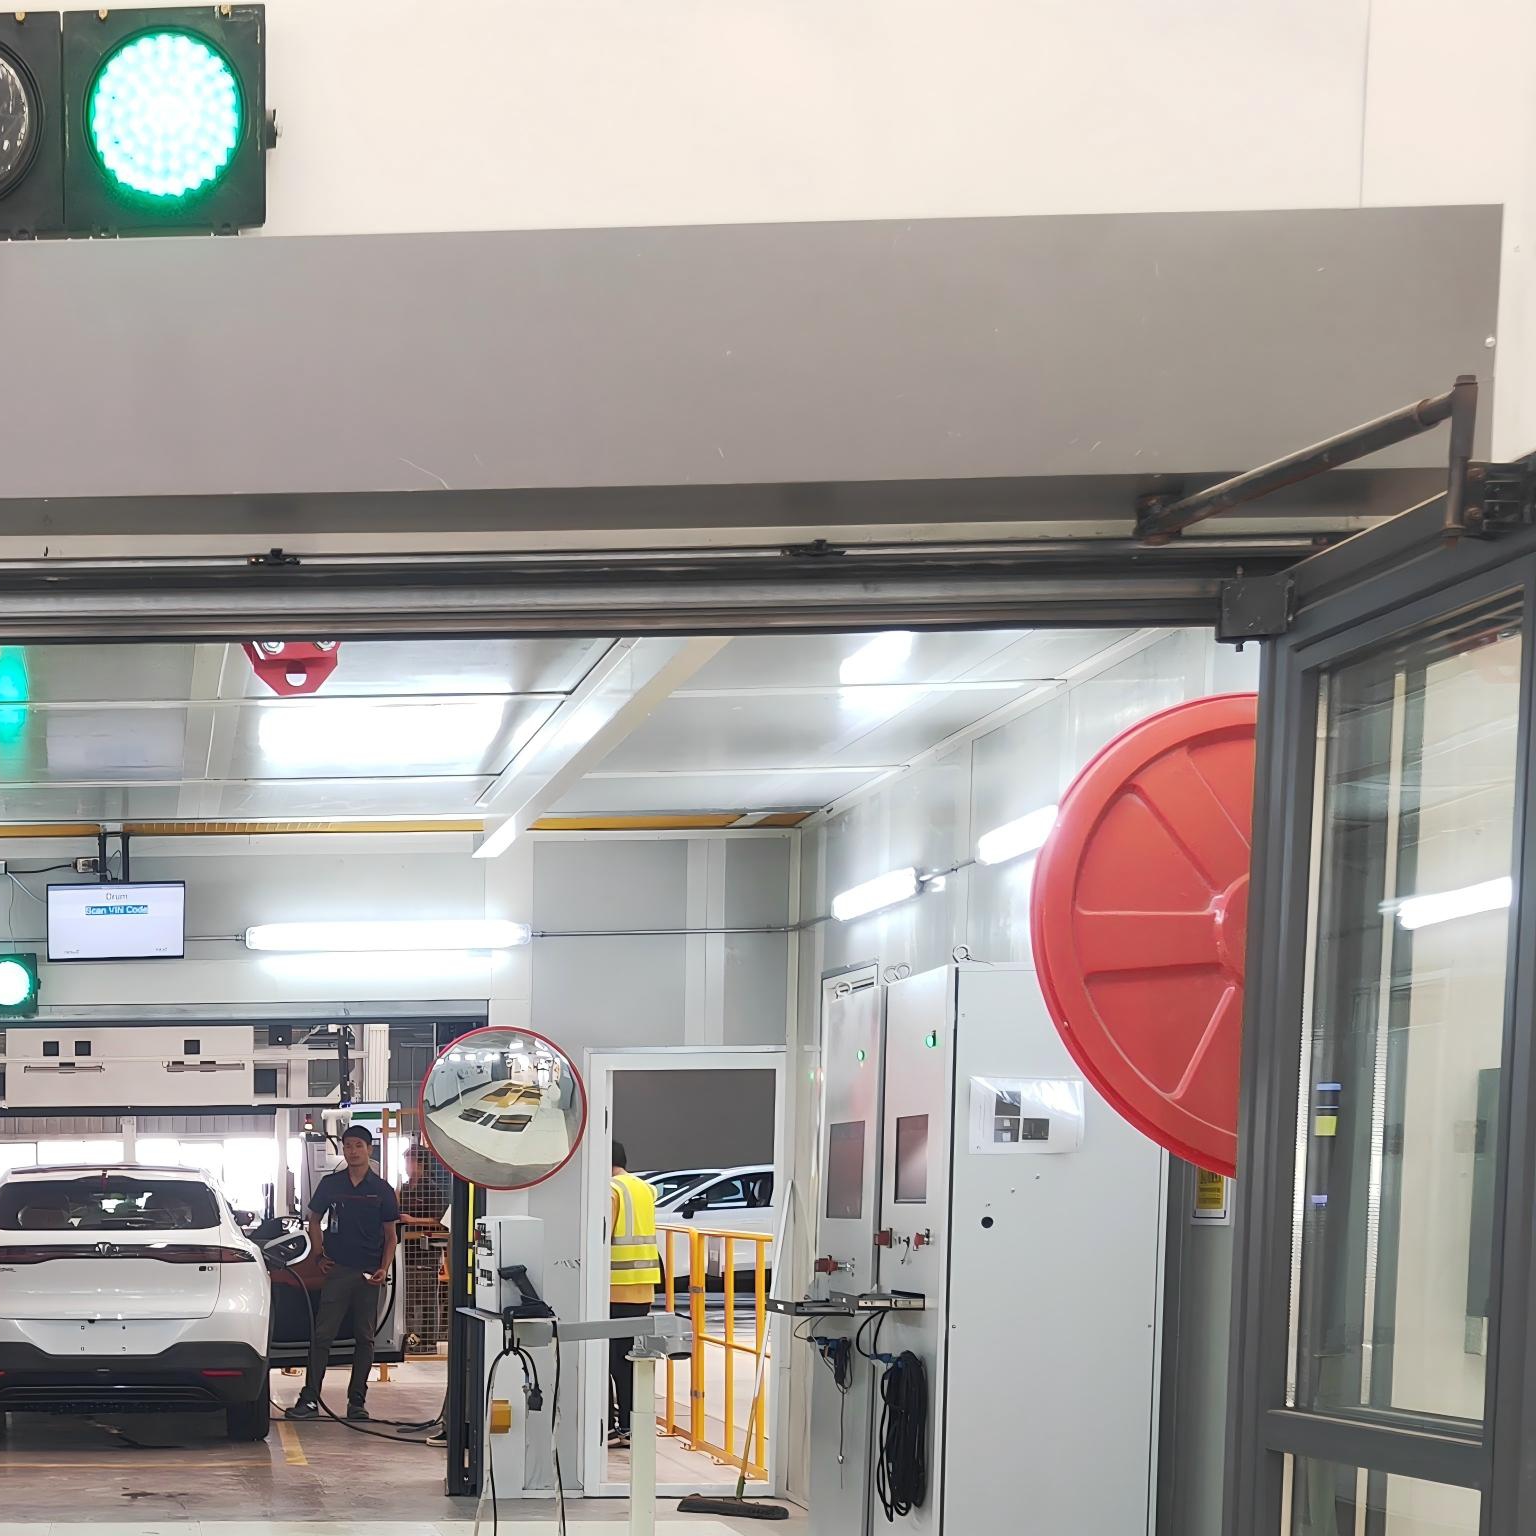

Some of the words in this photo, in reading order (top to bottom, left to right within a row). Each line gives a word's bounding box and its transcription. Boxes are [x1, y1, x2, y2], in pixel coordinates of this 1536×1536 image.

[85, 906, 107, 915] Scan
[108, 906, 125, 914] VIN
[126, 905, 148, 914] Code
